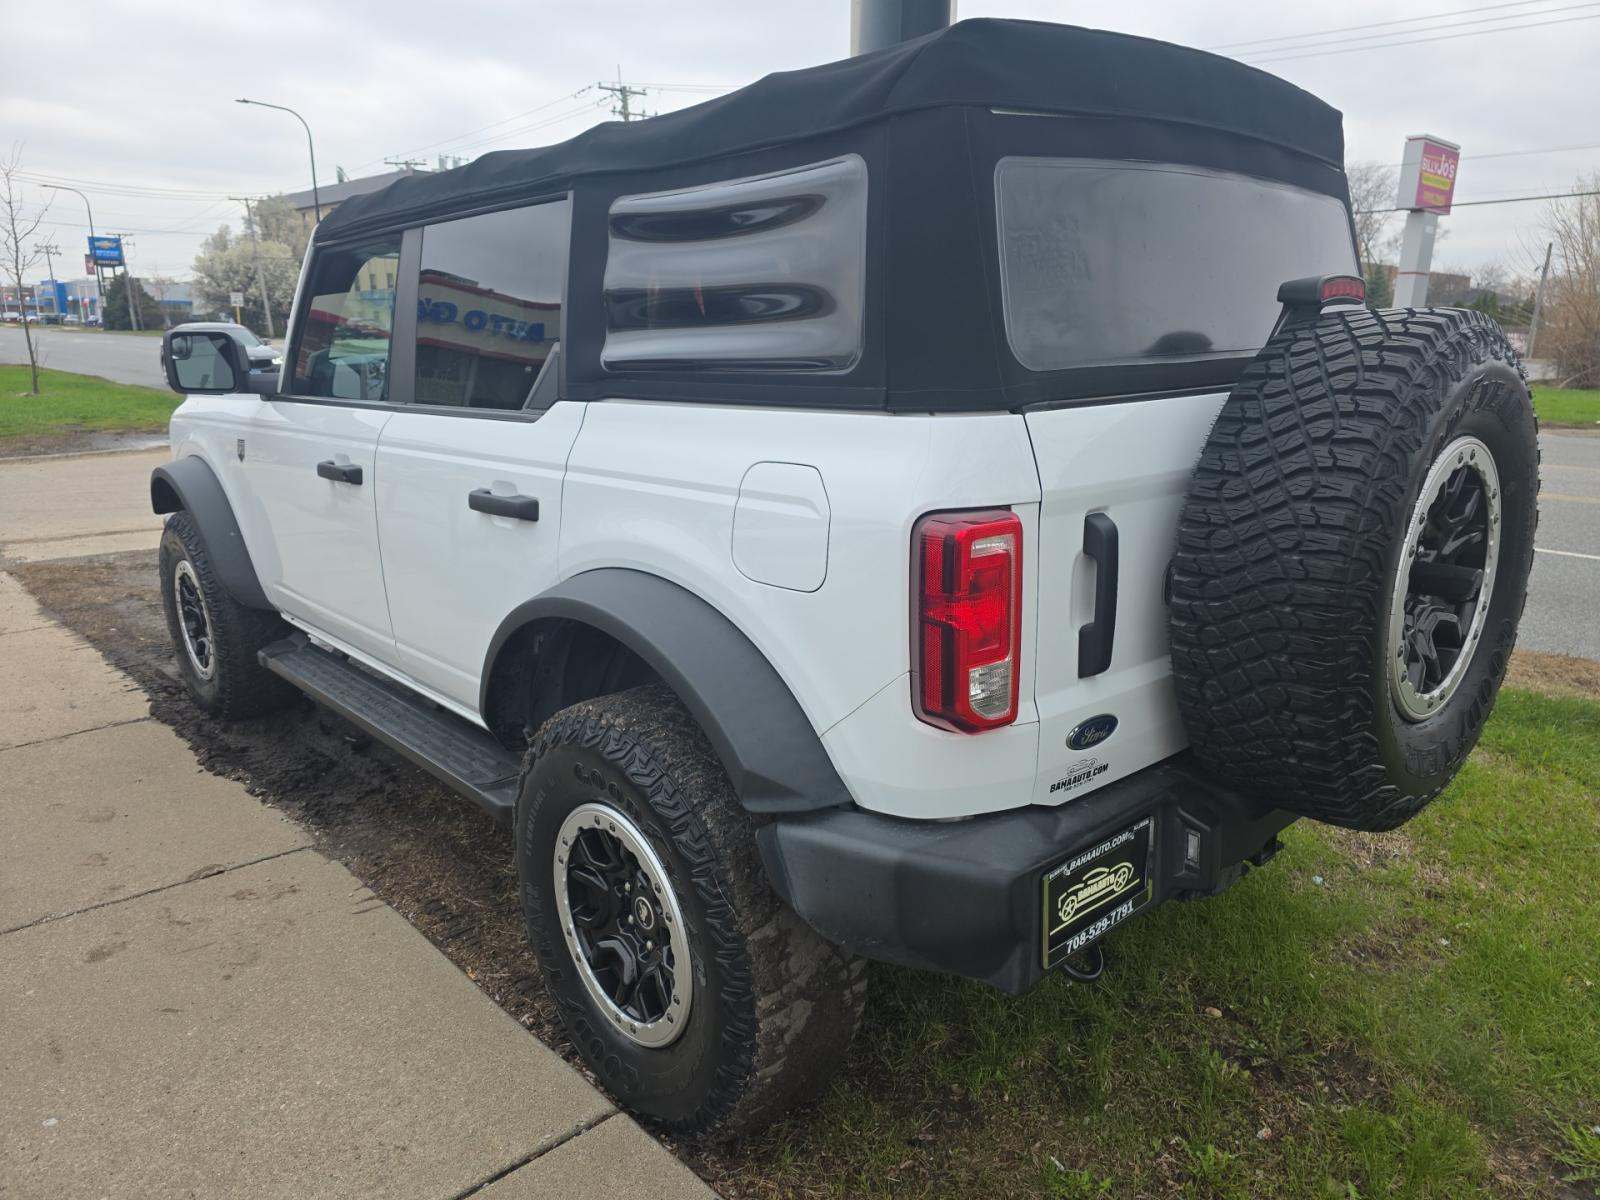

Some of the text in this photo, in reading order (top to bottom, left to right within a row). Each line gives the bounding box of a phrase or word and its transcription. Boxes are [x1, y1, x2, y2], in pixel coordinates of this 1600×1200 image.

[1049, 763, 1109, 793] BAHAAUTO.COM
[1069, 832, 1129, 871] BAHAAUTO.COM
[1066, 899, 1135, 954] 708-529-7791
